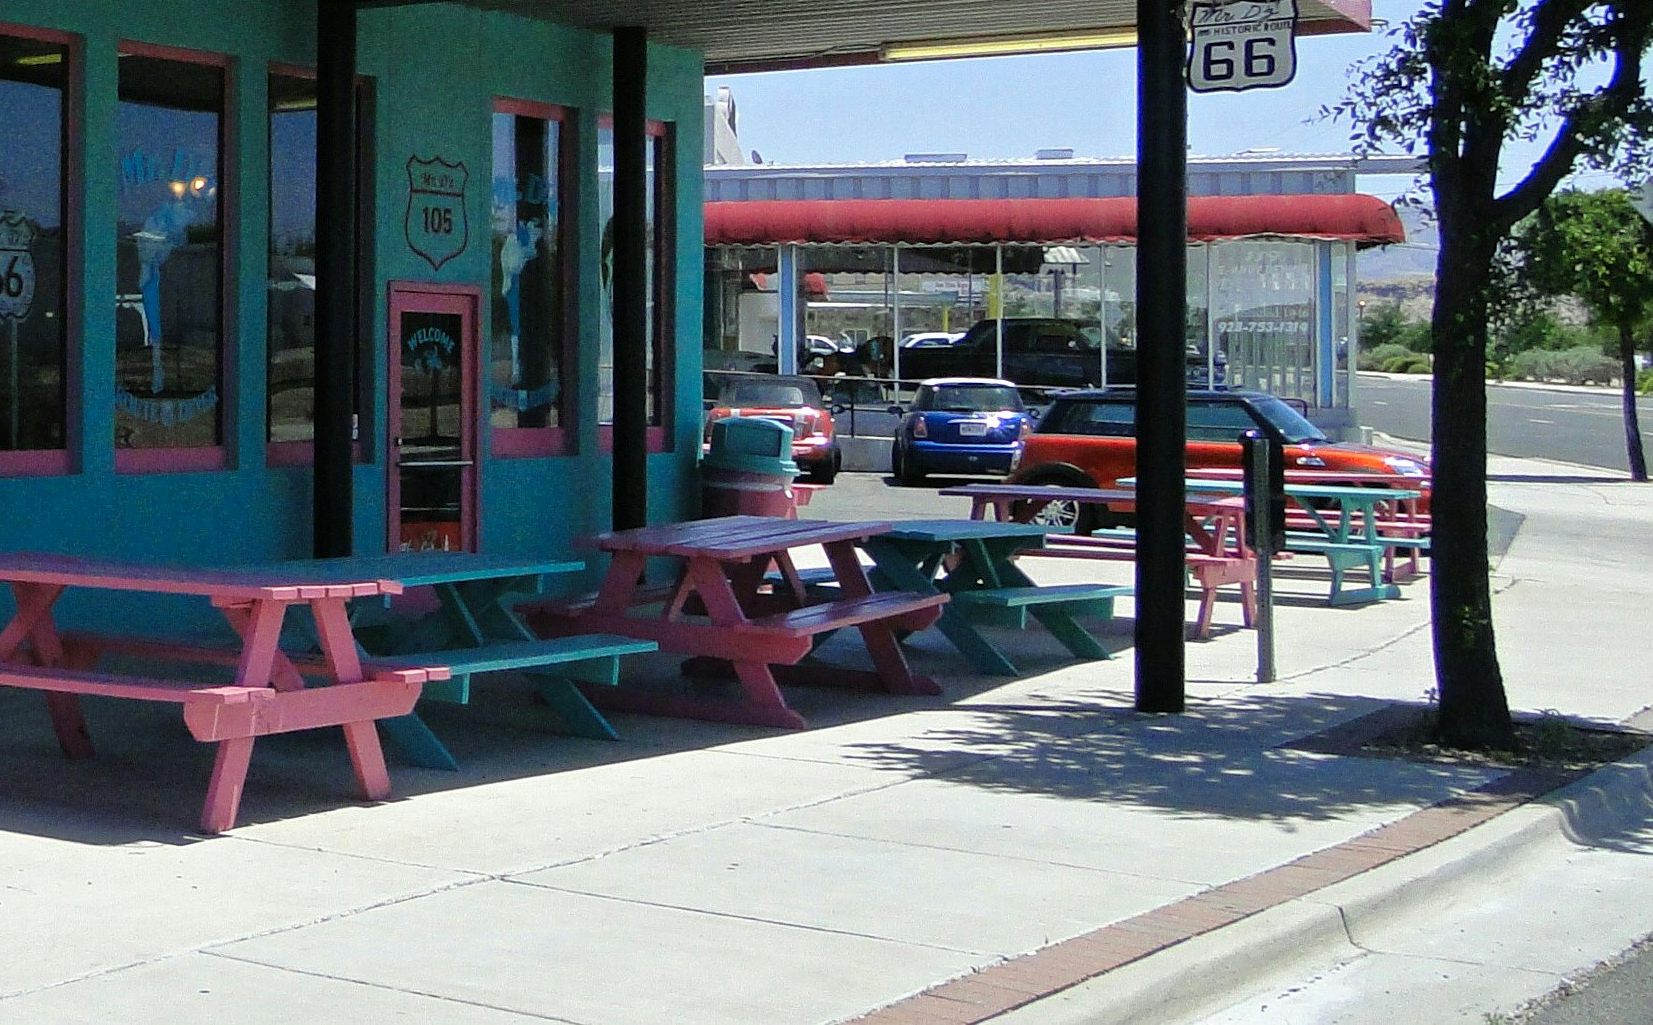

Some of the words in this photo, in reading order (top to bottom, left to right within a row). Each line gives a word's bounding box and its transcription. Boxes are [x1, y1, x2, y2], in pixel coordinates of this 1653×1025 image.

[1213, 23, 1261, 35] HISTORIC
[1203, 37, 1277, 81] 66
[422, 206, 453, 234] 105
[407, 326, 456, 354] WELCOME
